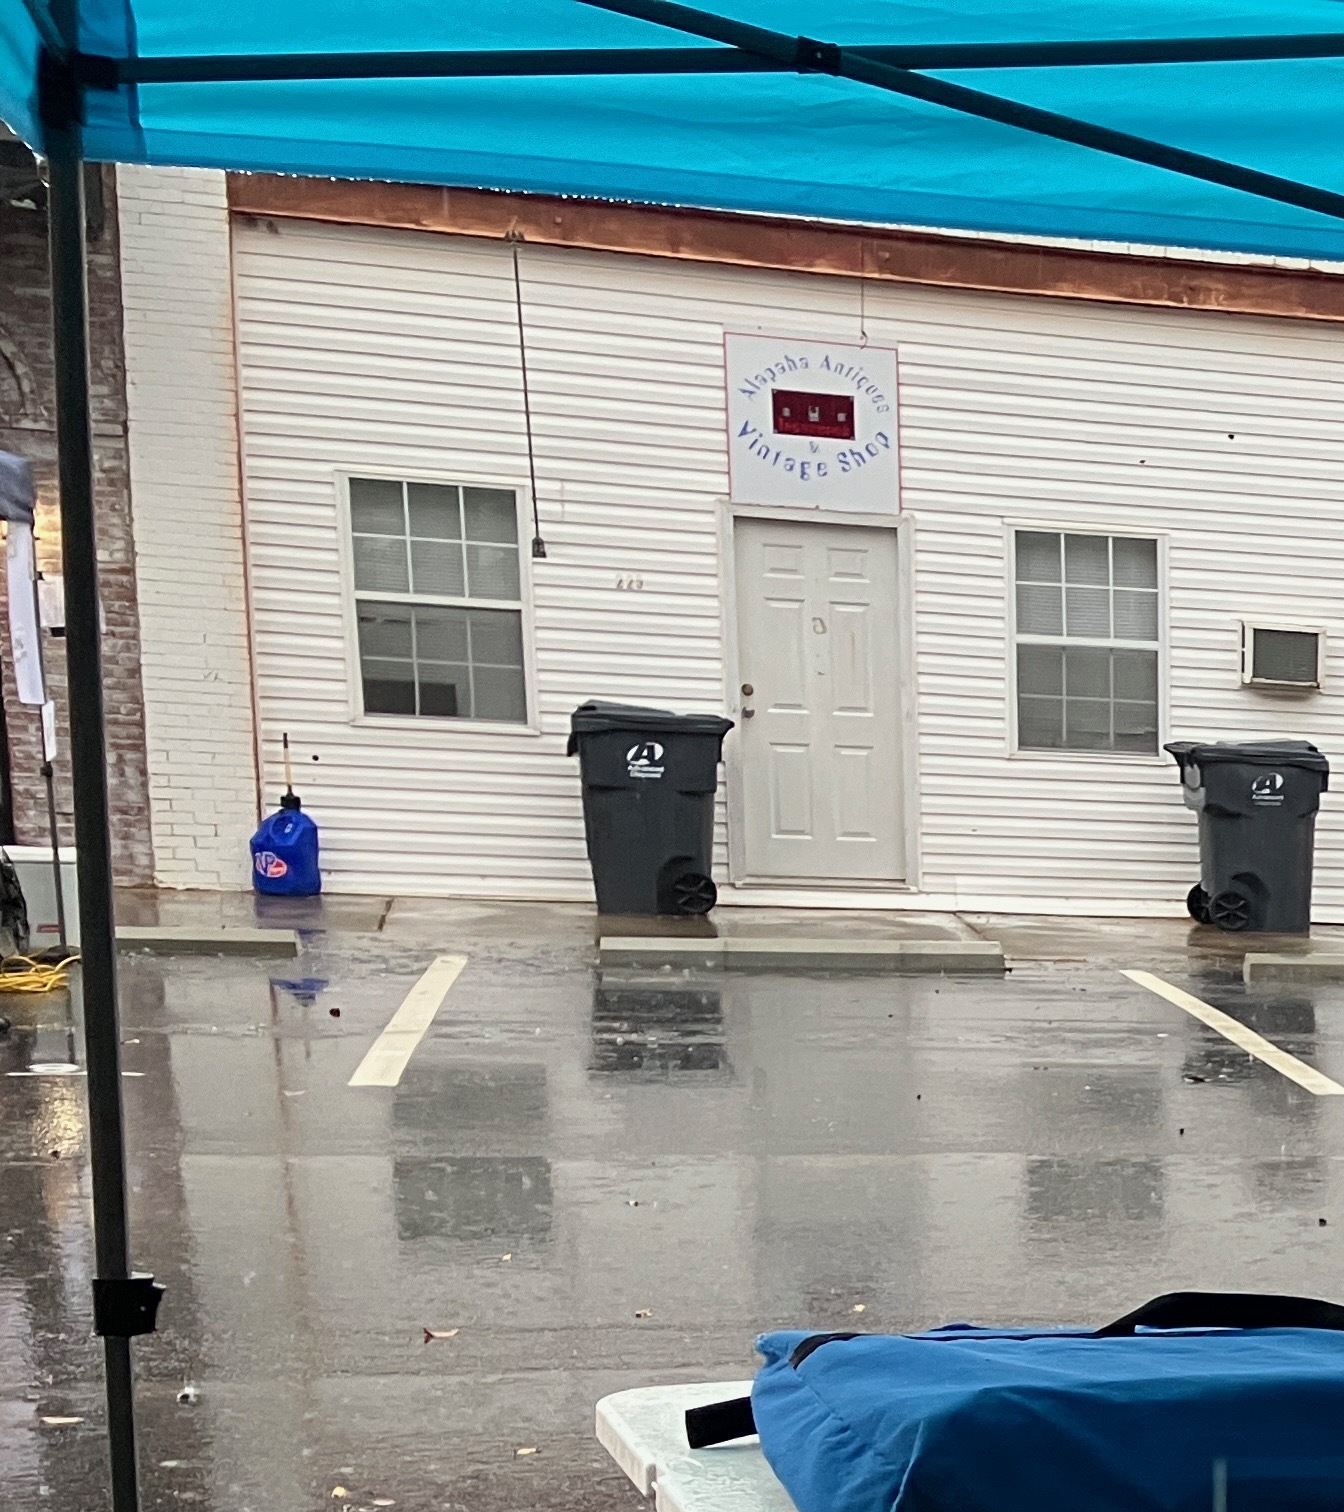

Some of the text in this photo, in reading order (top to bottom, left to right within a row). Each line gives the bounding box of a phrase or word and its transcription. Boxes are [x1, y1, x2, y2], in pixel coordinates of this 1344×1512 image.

[737, 354, 890, 414] Alapaha Antiques
[737, 420, 828, 481] Vintage
[836, 431, 890, 473] Shop
